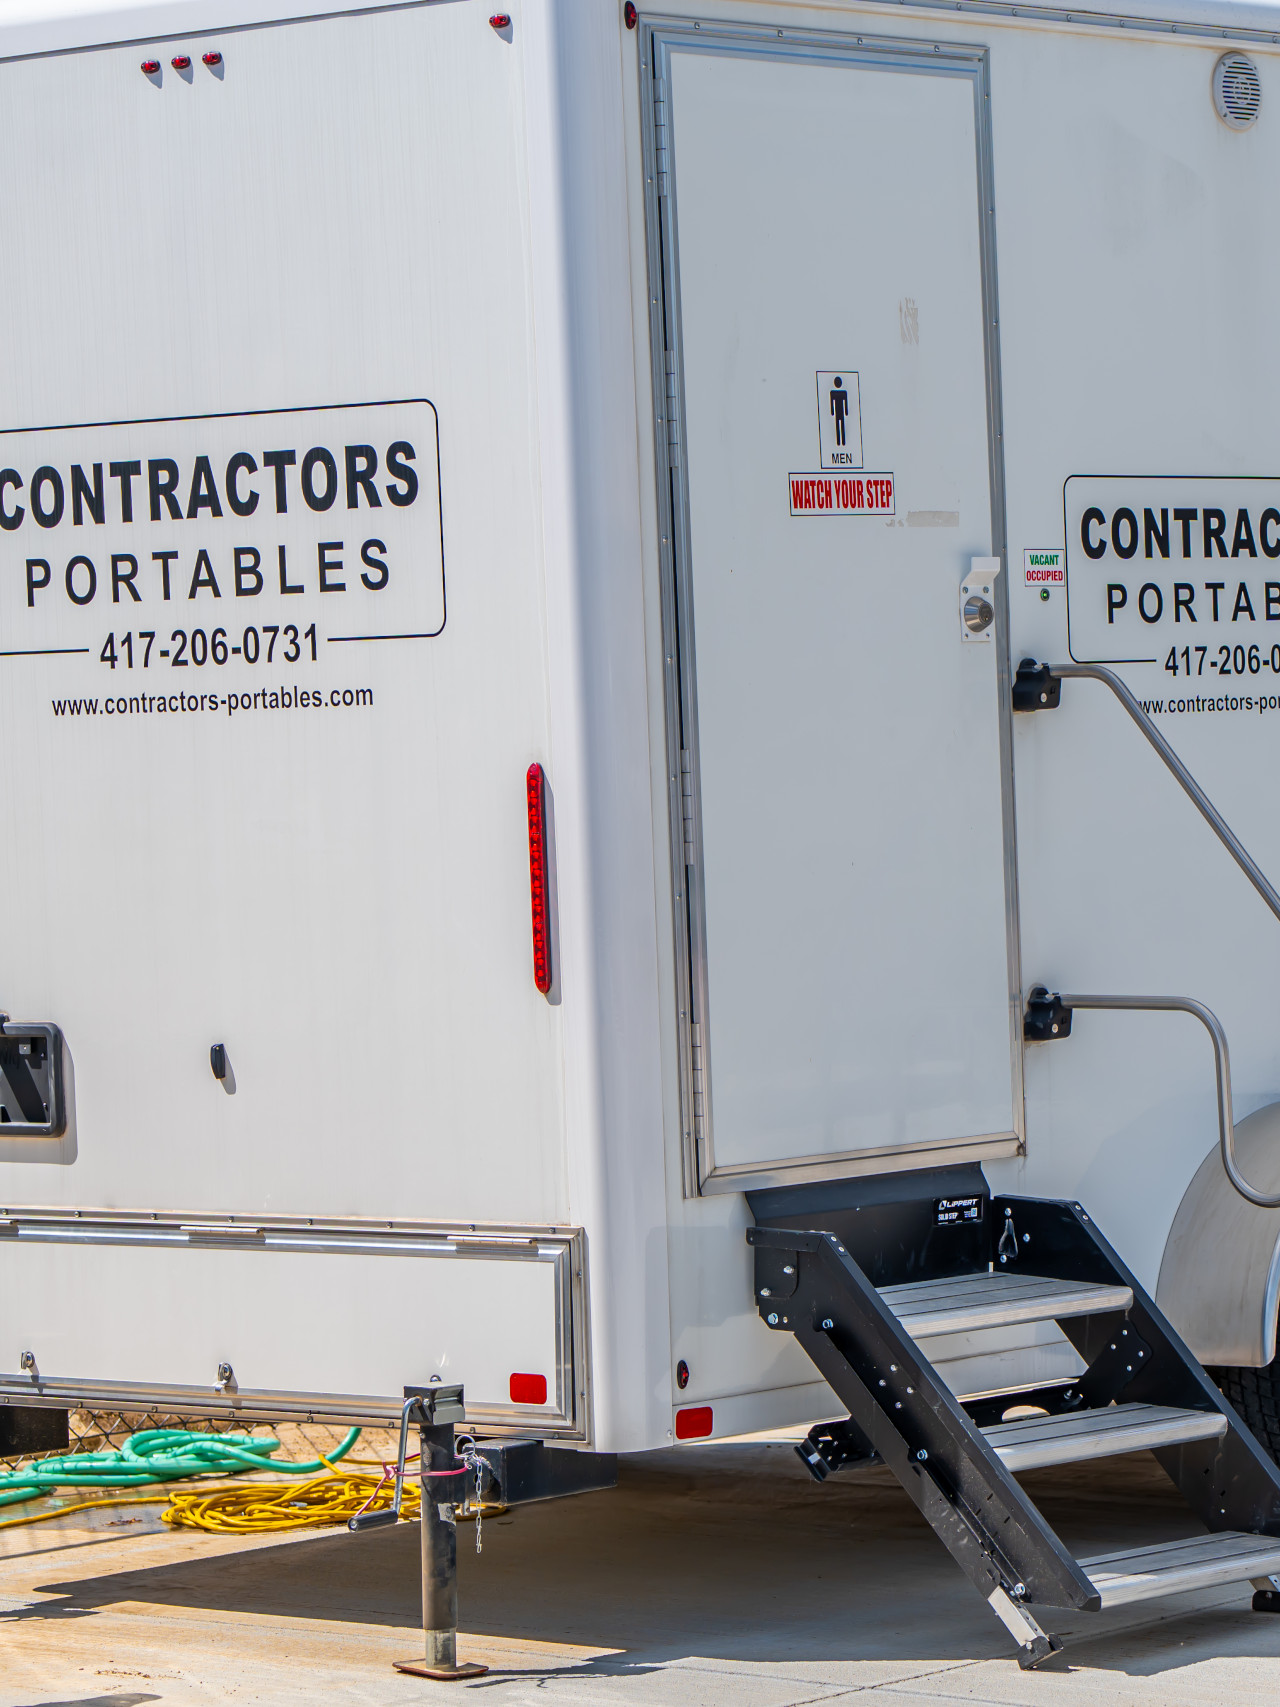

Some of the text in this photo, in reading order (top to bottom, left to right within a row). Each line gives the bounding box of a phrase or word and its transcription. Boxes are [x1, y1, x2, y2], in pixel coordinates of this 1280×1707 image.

[831, 453, 852, 464] MEN
[0, 440, 419, 531] CONTRACTORS
[791, 479, 893, 509] WATCH YOUR STEP
[25, 538, 390, 608] PORTABLES
[1029, 554, 1060, 566] VACANT
[1026, 570, 1064, 582] OCCUPIED
[100, 623, 319, 670] 417-206-0731
[52, 685, 374, 716] www.contractors-portables.com
[947, 1199, 979, 1208] LIPPERT
